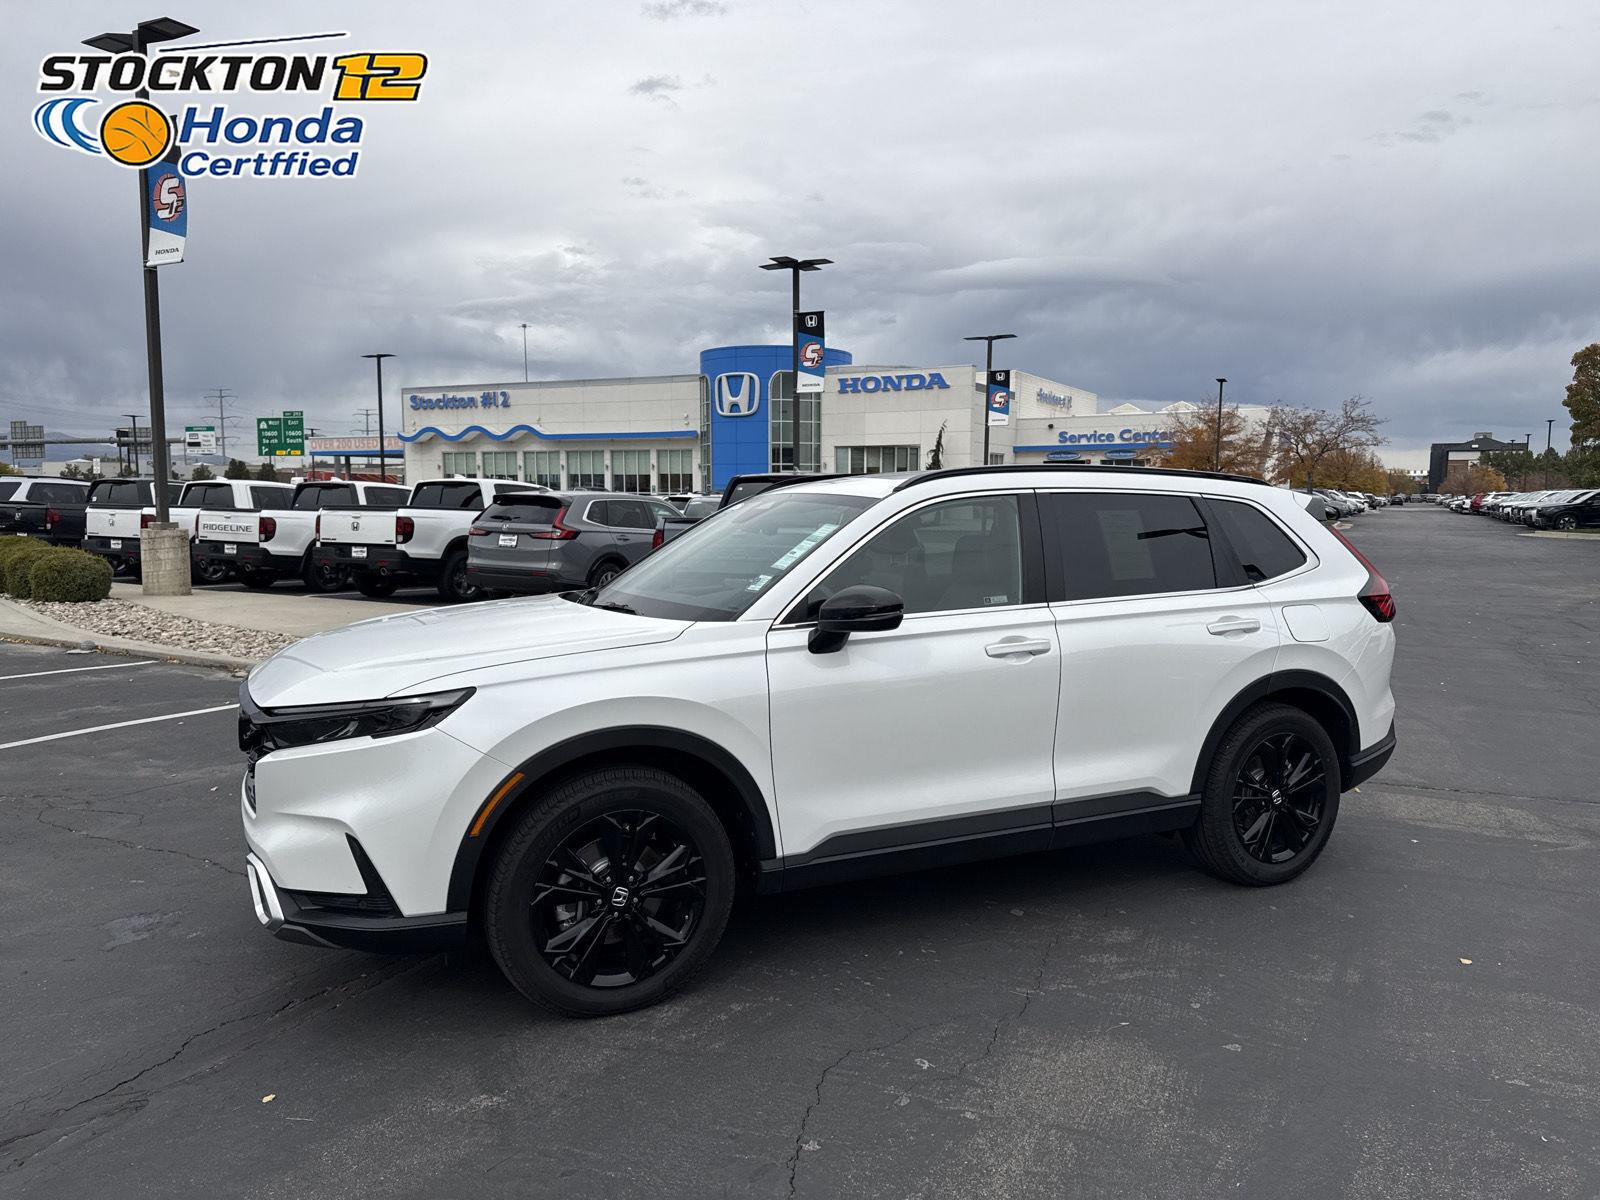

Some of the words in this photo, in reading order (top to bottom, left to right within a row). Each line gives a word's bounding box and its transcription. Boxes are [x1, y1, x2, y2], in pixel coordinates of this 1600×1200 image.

[838, 372, 950, 394] HONDA
[409, 394, 478, 411] Stockton
[1058, 431, 1115, 443] Service
[311, 440, 335, 450] OVER
[336, 439, 352, 449] 200
[354, 438, 378, 449] USED
[203, 523, 253, 533] RIDGELINE
